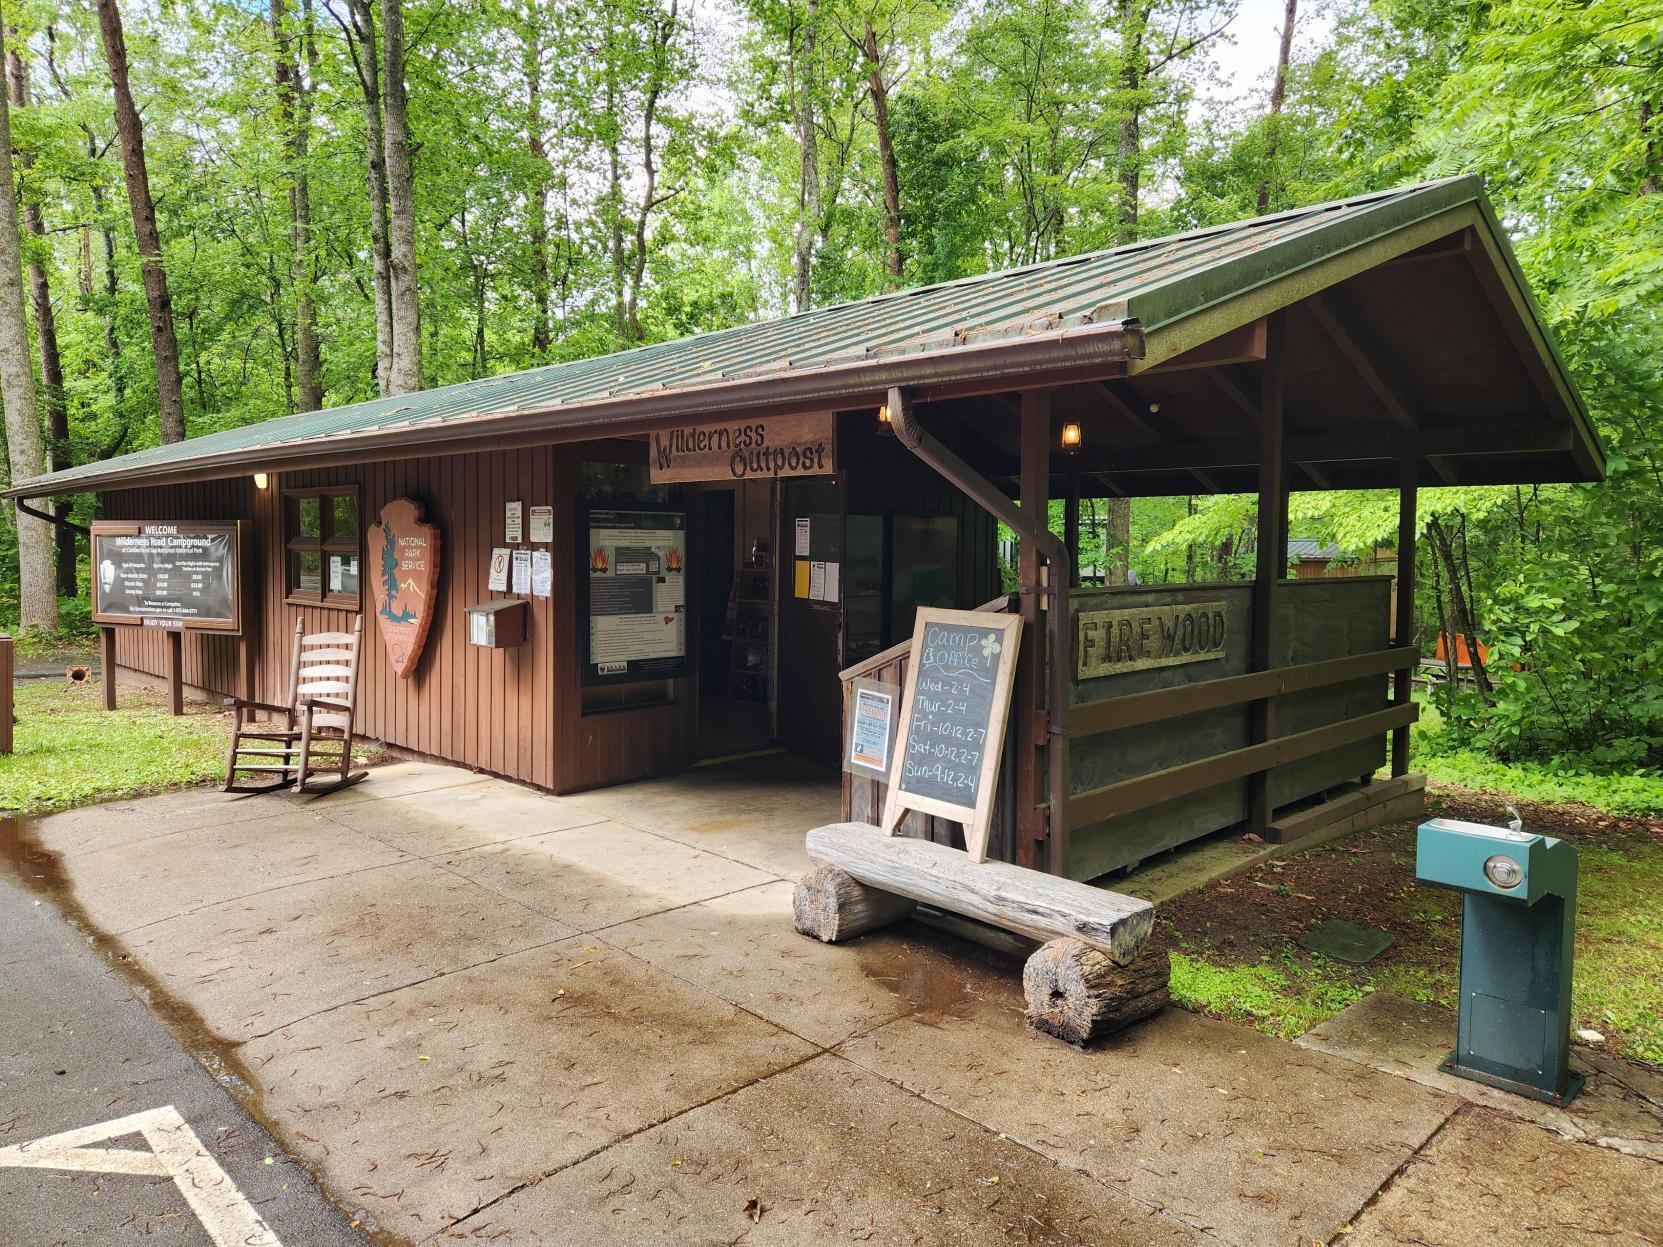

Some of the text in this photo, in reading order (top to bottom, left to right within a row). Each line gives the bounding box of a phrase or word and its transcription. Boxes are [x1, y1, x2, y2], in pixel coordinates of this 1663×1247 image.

[655, 423, 766, 471] Wilderness
[729, 441, 826, 478] Outpost
[145, 525, 178, 535] WELCOME
[115, 537, 211, 548] Wilderness Road Campground
[398, 537, 427, 546] NATIONAL
[404, 549, 421, 558] PARK
[401, 561, 425, 571] SERVICE
[927, 627, 979, 657] Camp
[1081, 611, 1225, 667] FIREWOOD
